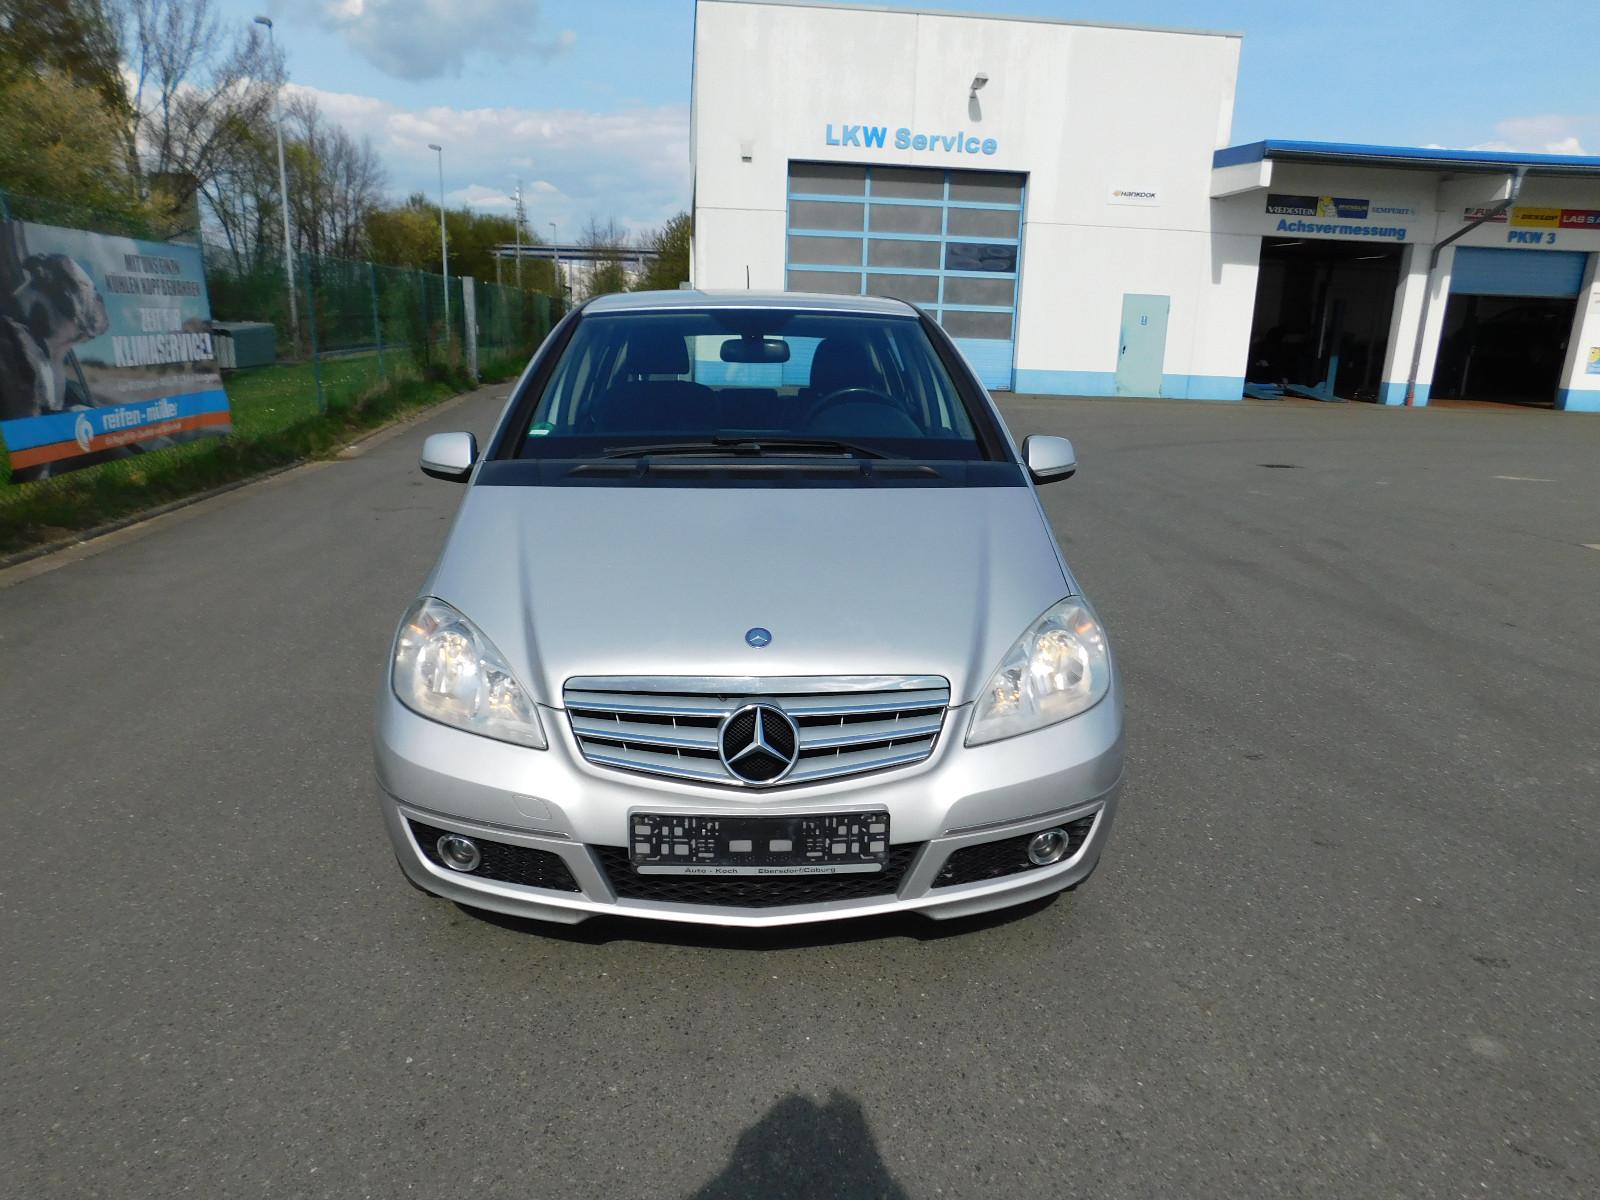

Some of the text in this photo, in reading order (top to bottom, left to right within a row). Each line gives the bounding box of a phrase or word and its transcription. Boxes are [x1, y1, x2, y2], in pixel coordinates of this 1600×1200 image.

[826, 124, 998, 155] LKW Service
[1276, 218, 1407, 240] Achsvermessung
[1507, 230, 1556, 244] PKW 3
[112, 333, 213, 368] KLIMASERVICE!
